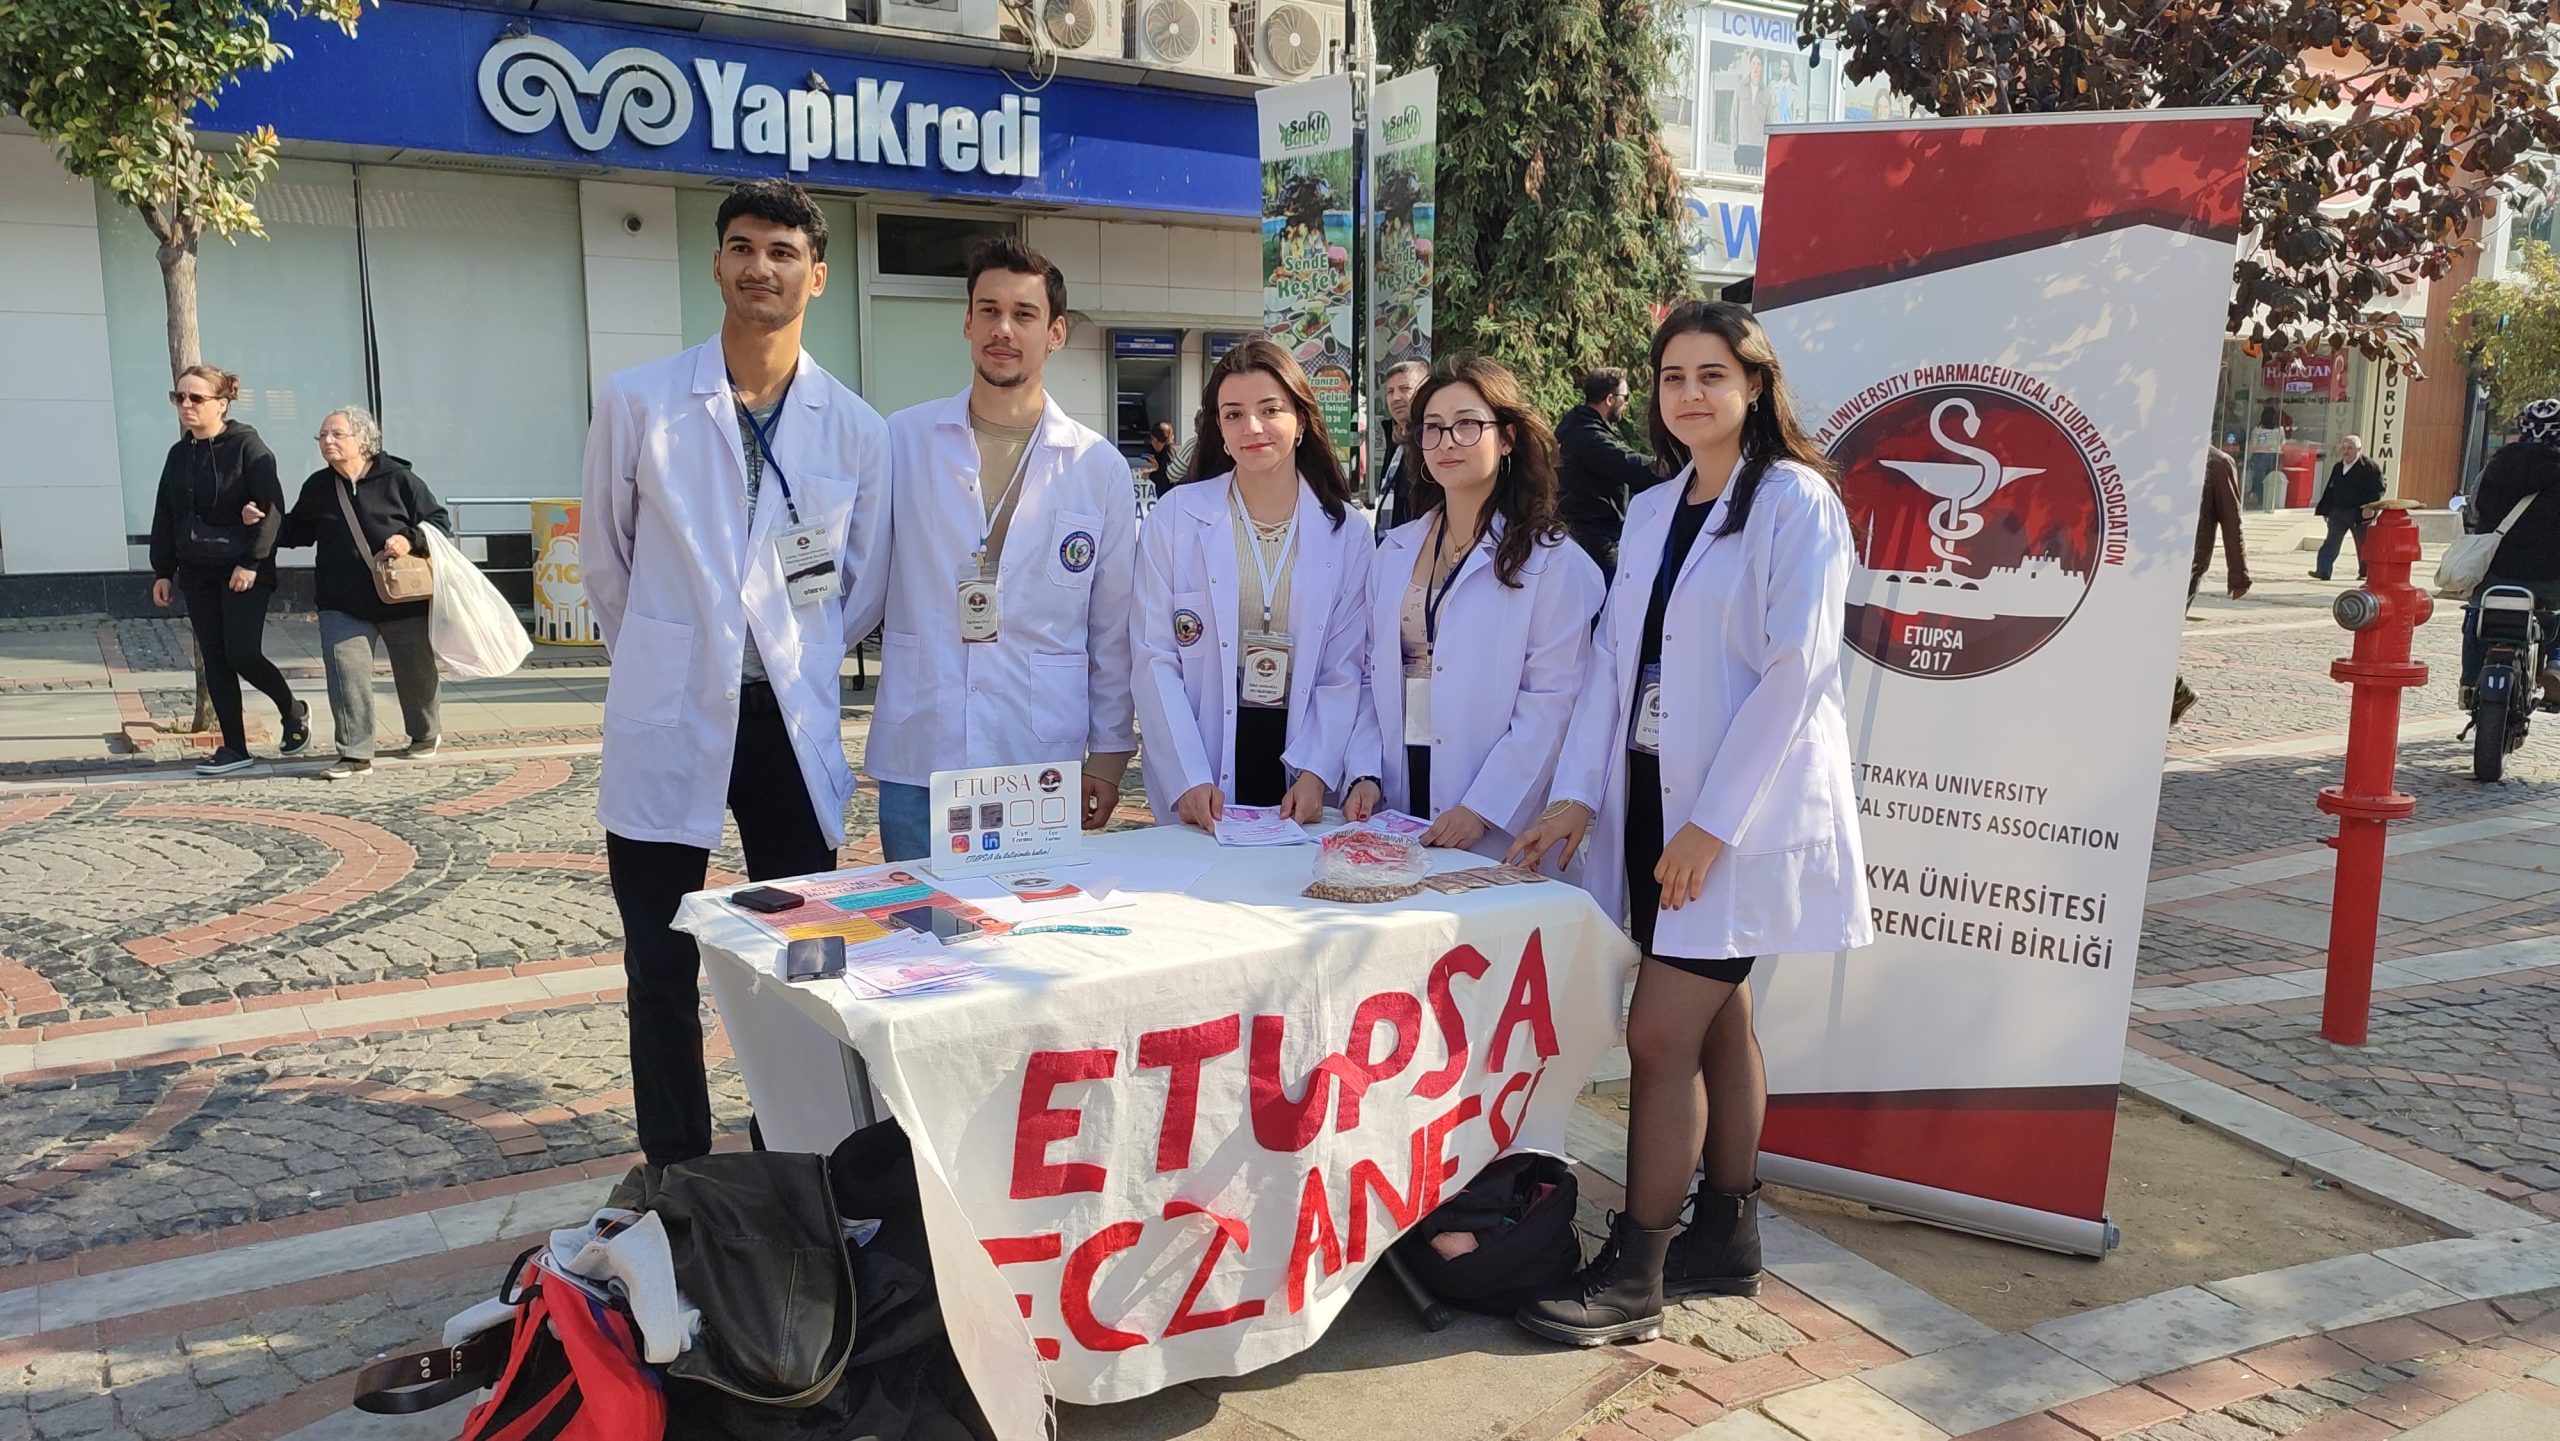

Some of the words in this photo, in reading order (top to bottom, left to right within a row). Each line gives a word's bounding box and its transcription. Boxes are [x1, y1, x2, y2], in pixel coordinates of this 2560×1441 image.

[1722, 12, 1747, 35] LC
[694, 58, 1041, 177] YapıKredi
[1277, 270, 1339, 299] Keşfet
[1828, 372, 1909, 430] UNIVERSITY
[1914, 363, 2052, 405] PHARMACEUTICAL
[2050, 395, 2111, 464] STUDENTS
[2098, 463, 2129, 567] ASSOCIATION
[1903, 625, 1963, 650] ETUPSA
[1909, 648, 1952, 671] 2017
[954, 774, 1031, 798] ETUPSA
[1861, 763, 1929, 790] TRAKYA
[1935, 773, 2048, 805] UNIVERSITY
[1886, 801, 1982, 831] STUDENTS
[1986, 815, 2119, 850] ASSOCIATION
[1865, 863, 1910, 894] KYA
[1919, 867, 2107, 924] ÜNİVERSİTESİ
[1872, 906, 2003, 952] RENCİLERİ
[2011, 926, 2113, 970] BİRLİĞİ
[1008, 926, 1560, 1200] ETUPSA
